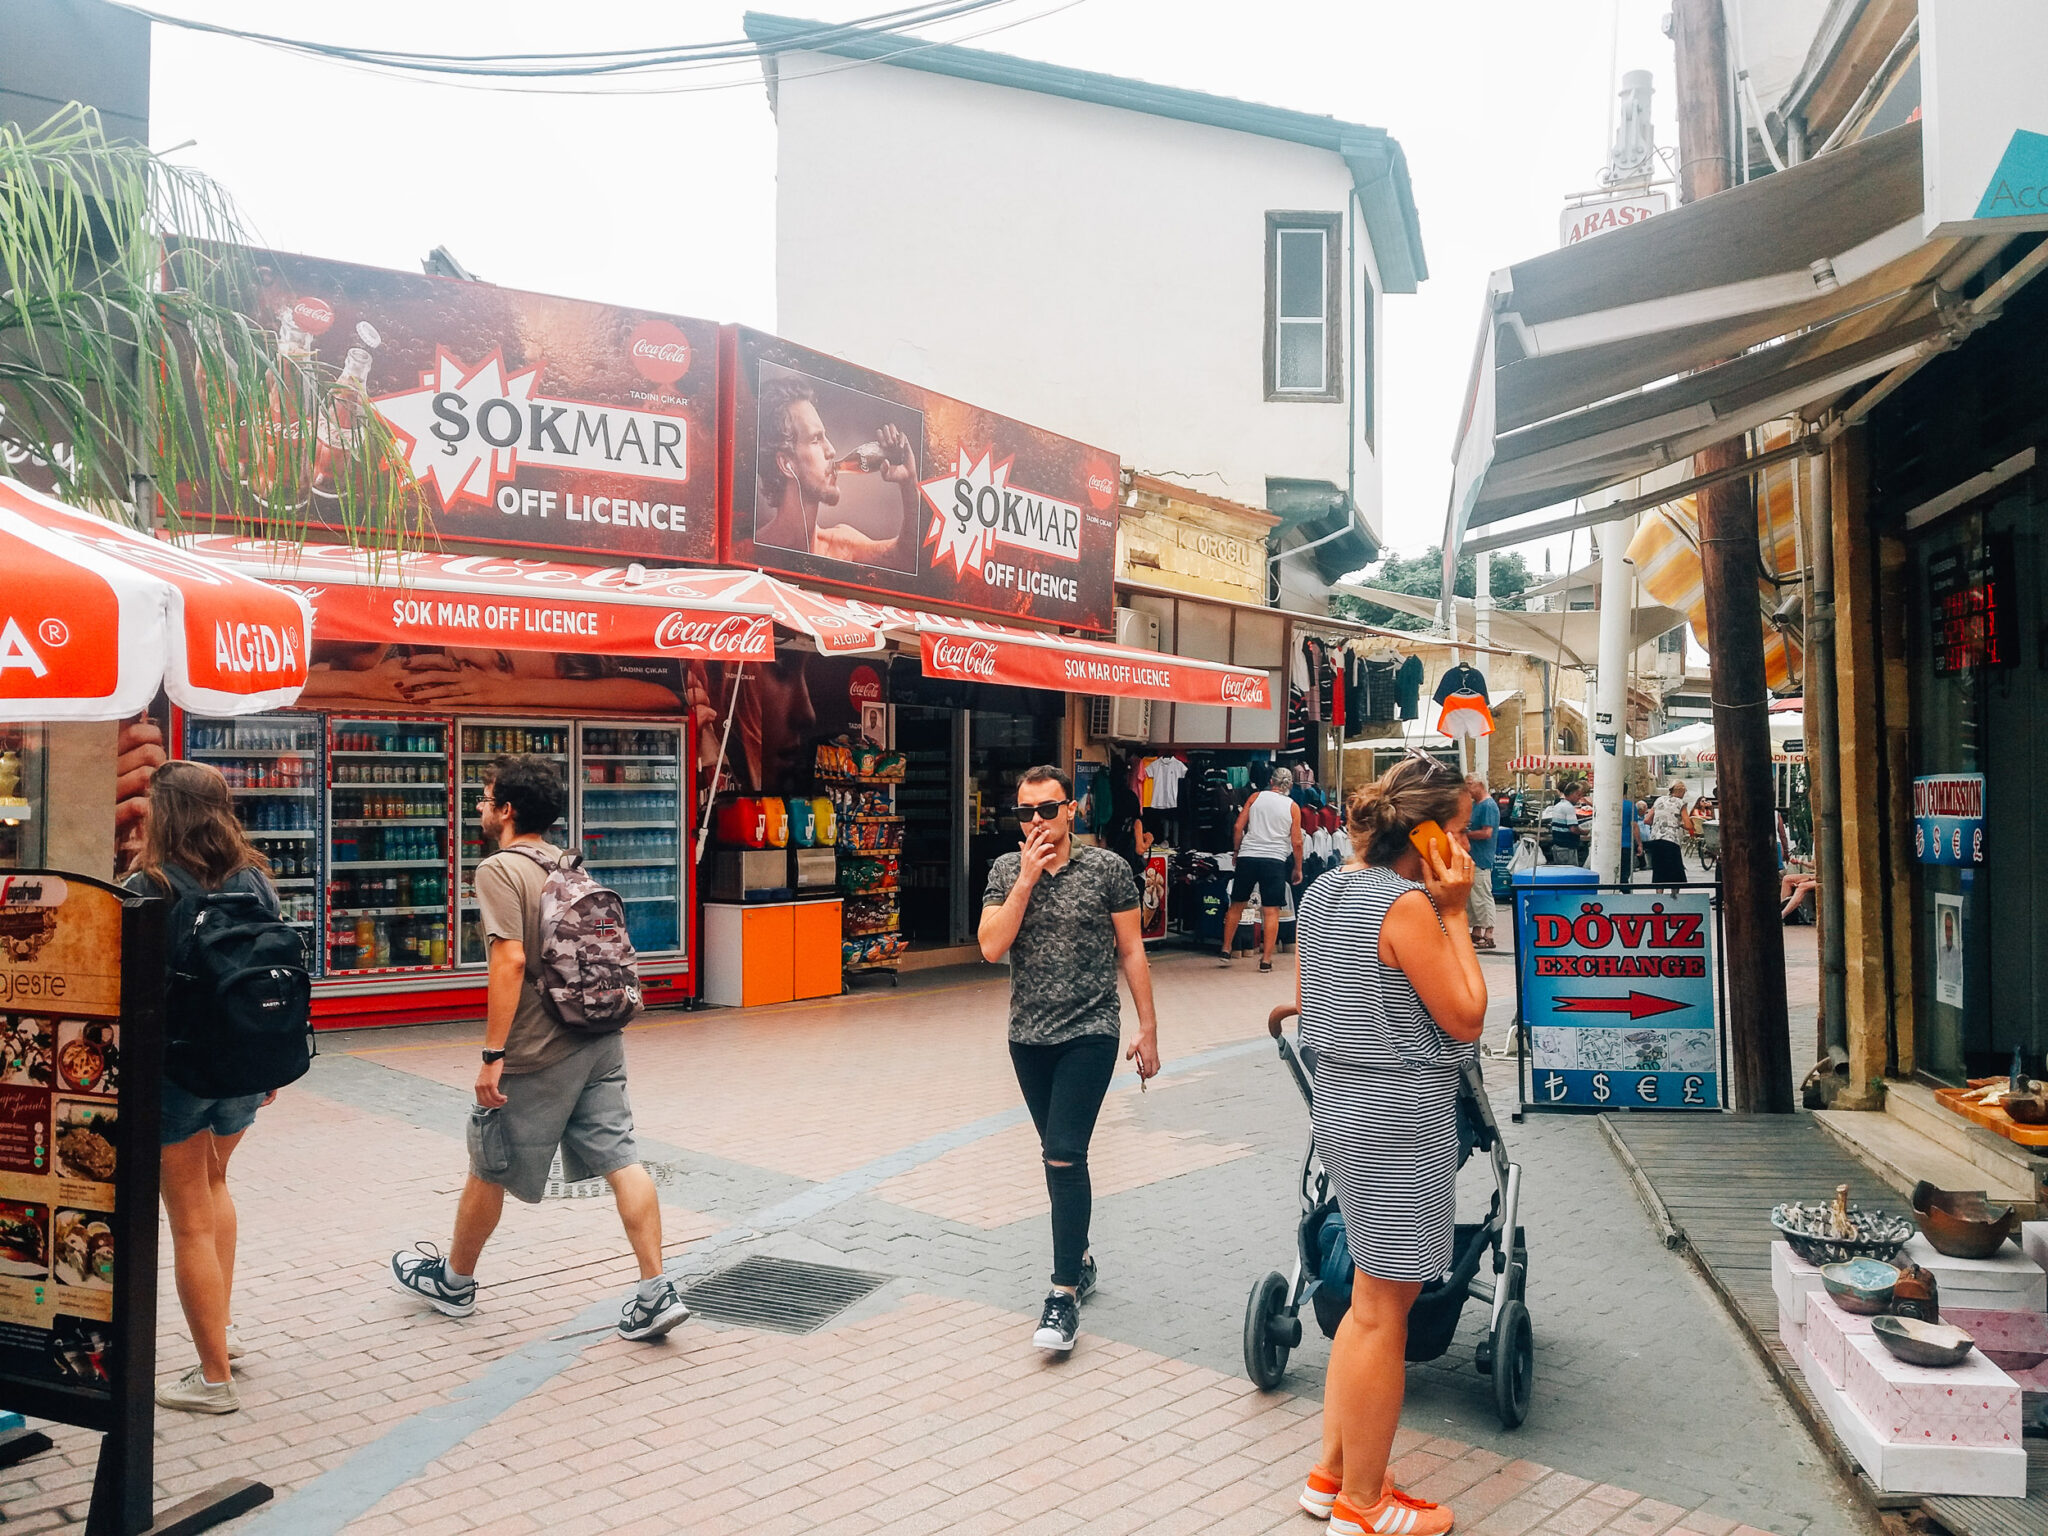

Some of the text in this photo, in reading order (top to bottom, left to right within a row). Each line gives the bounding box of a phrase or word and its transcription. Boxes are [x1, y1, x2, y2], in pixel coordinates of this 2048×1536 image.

[633, 338, 689, 363] Coca-Cola
[630, 390, 659, 402] TADINI
[429, 391, 683, 469] ŞOKMAR
[496, 486, 686, 532] OFF LICENCE
[952, 478, 1077, 550] ŞOKMAR
[984, 561, 1078, 603] OFF LICENCE
[392, 600, 598, 635] ŞOK MAR OFF LICENCE
[654, 611, 772, 654] Coca-Cola
[619, 665, 644, 675] TADINI
[932, 636, 998, 675] Coca-Cola
[850, 681, 879, 698] Coca-Cola
[1065, 659, 1171, 688] ŞOK MAR OFF LICENCE
[1221, 673, 1264, 703] Coca-Cola
[1913, 777, 1983, 820] NO COMMISSION
[1533, 902, 1704, 949] DÖVİZ
[1534, 955, 1706, 978] EXCHANGE
[1592, 1072, 1611, 1102] $
[1636, 1076, 1657, 1102] €
[1683, 1075, 1704, 1104] £
